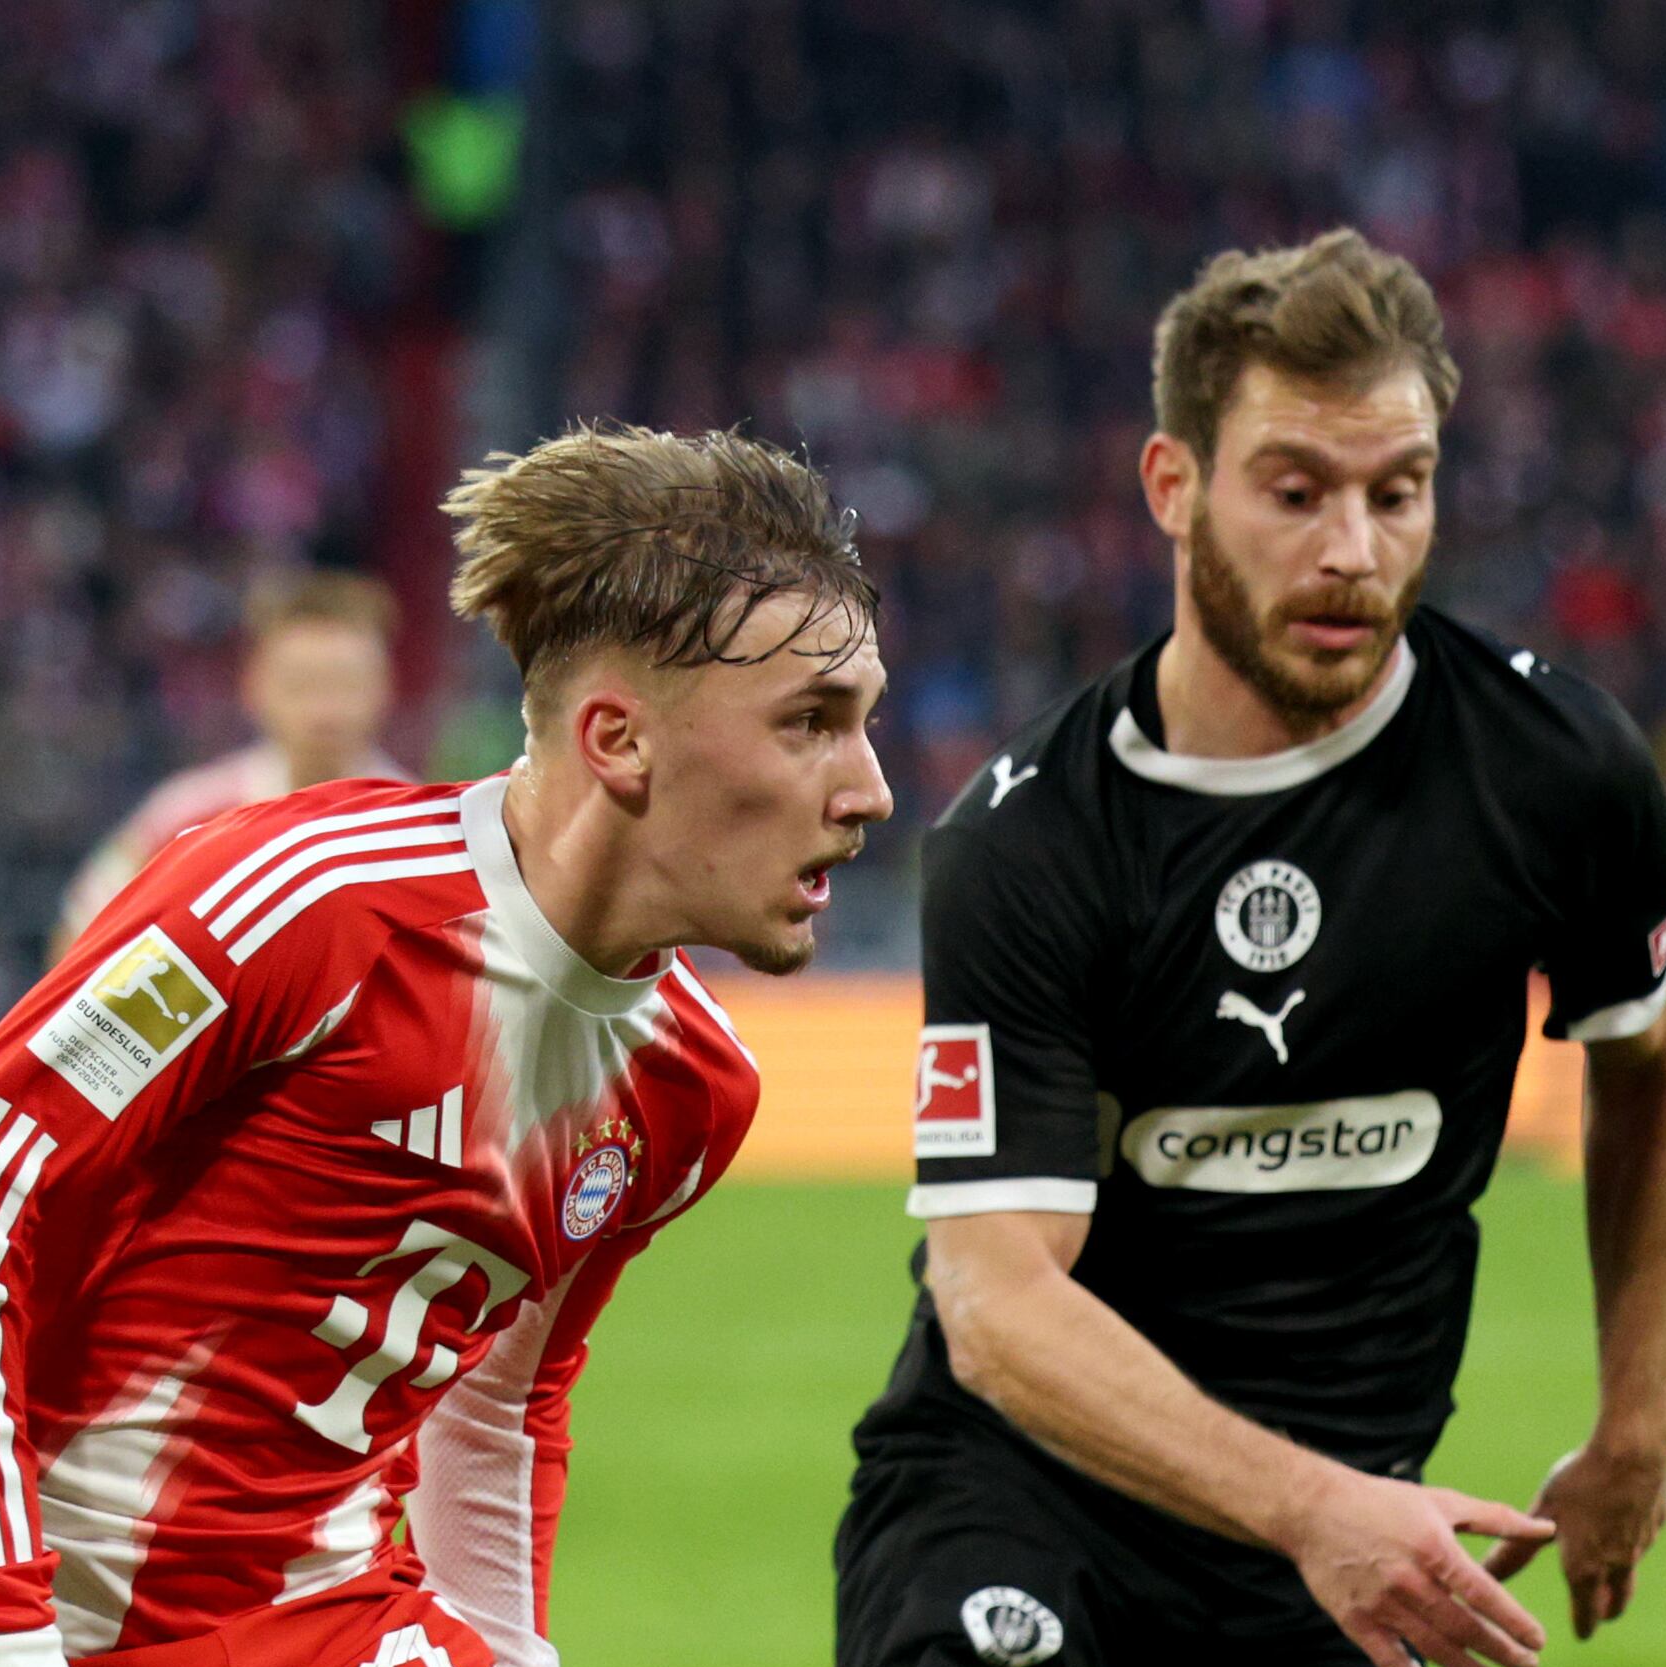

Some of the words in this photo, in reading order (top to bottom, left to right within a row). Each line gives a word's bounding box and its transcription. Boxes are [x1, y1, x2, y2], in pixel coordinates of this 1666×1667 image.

[68, 1034, 118, 1078] DEUTSCHER
[76, 998, 152, 1069] BUNDESLIGA
[48, 1030, 124, 1098] FUSSBALLMEISTER
[56, 1052, 101, 1091] 2024/2025
[1158, 1118, 1414, 1172] congstar
